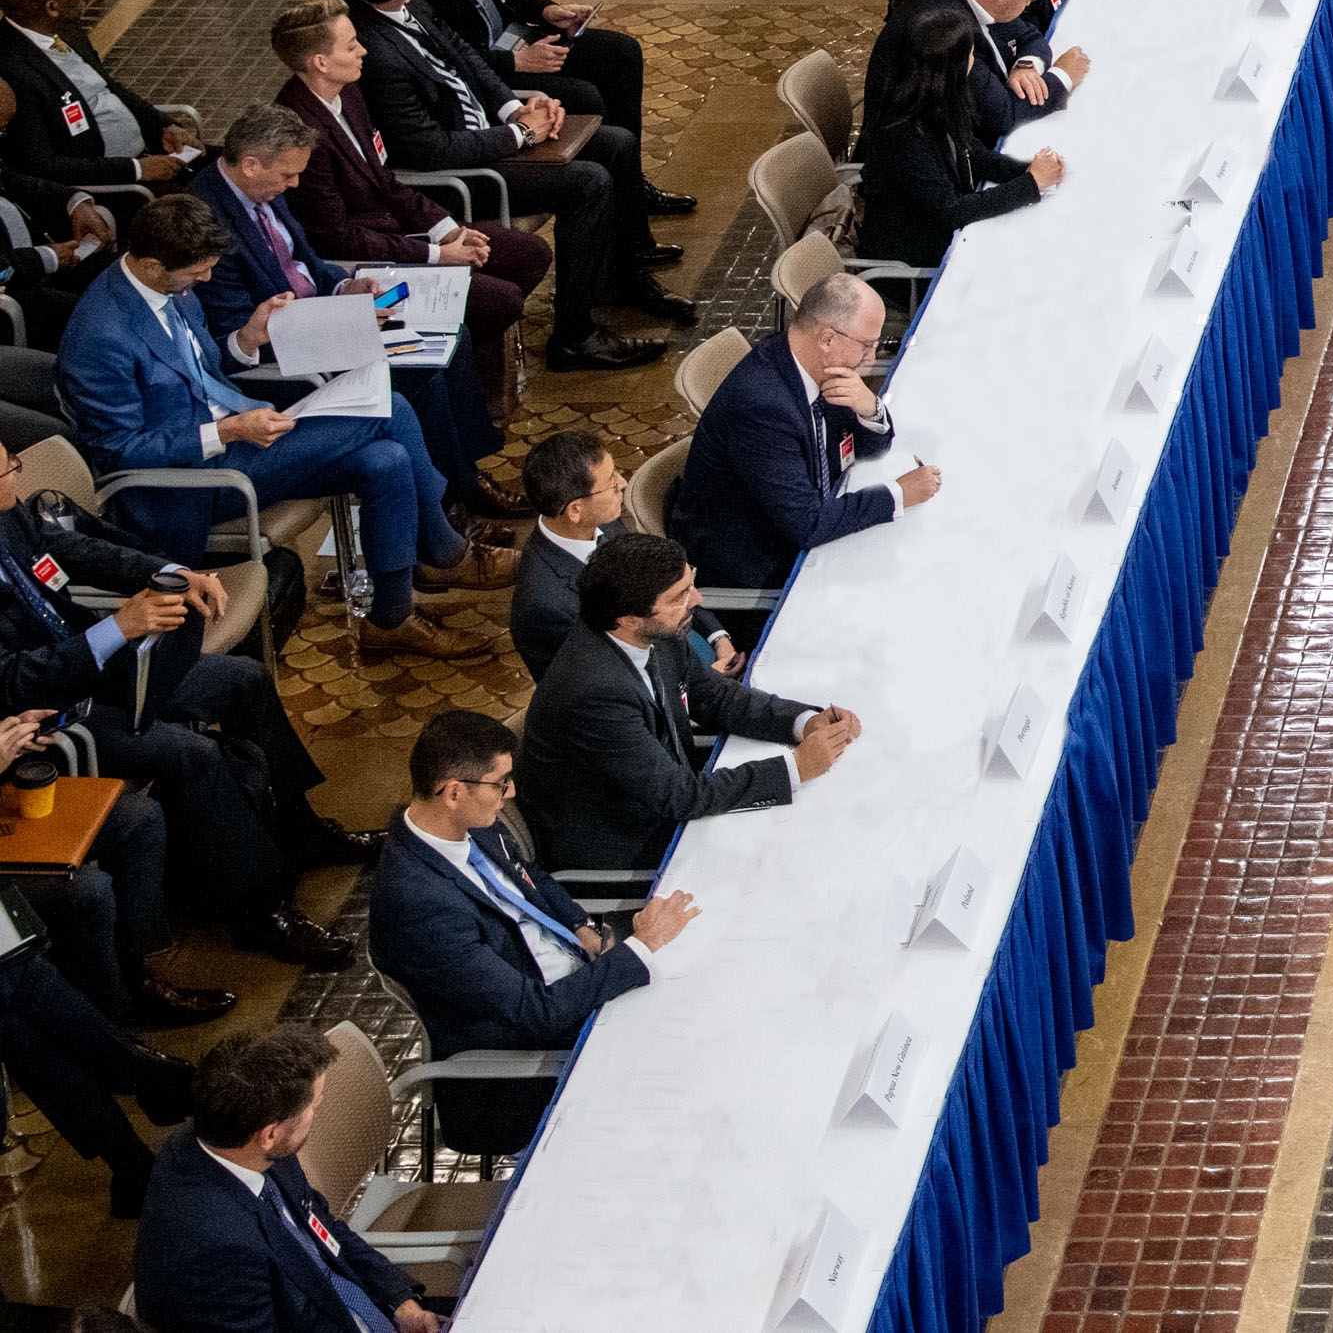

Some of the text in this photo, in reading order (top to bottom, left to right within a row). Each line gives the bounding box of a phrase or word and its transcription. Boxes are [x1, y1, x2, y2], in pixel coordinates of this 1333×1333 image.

[1016, 714, 1033, 744] Portugal
[959, 882, 976, 911] Poland
[883, 1035, 914, 1105] Papua New Guinea
[827, 1251, 846, 1289] Norway
